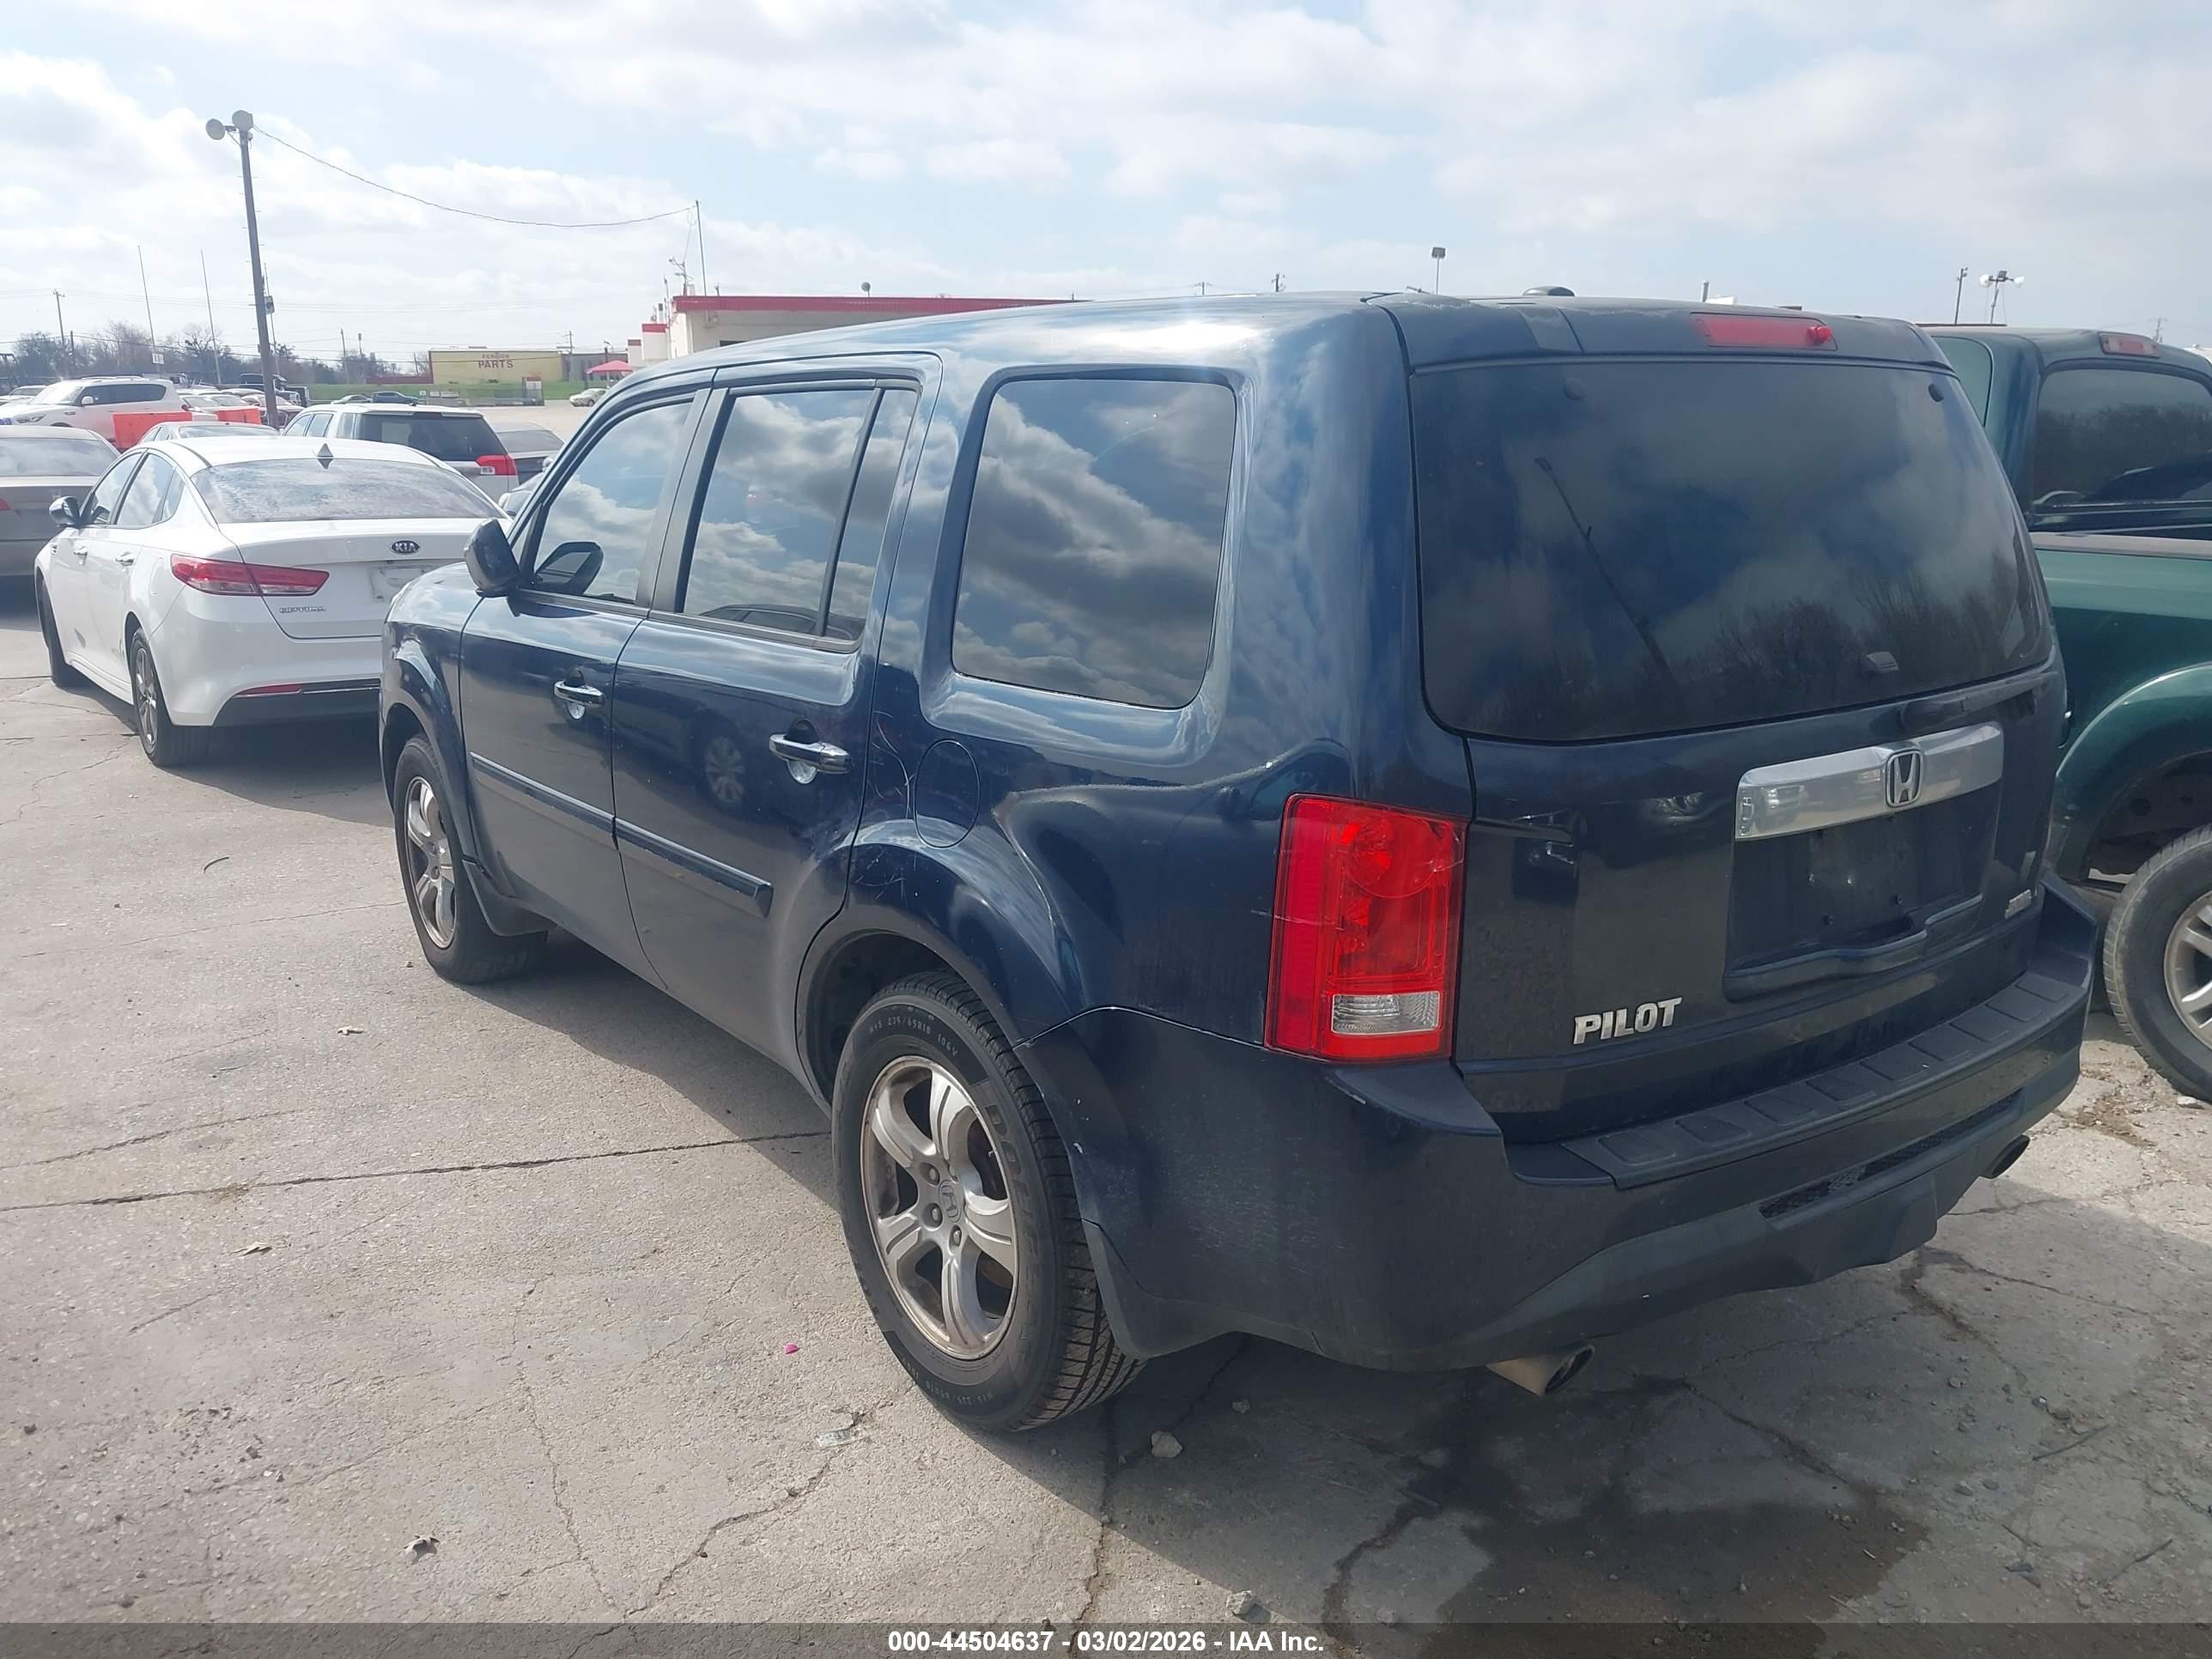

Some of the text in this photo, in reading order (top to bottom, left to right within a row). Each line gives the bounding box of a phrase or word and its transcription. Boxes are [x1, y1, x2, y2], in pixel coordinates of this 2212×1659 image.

[478, 360, 514, 368] PARTS
[395, 543, 416, 551] KIA
[1573, 997, 1682, 1045] PILOT
